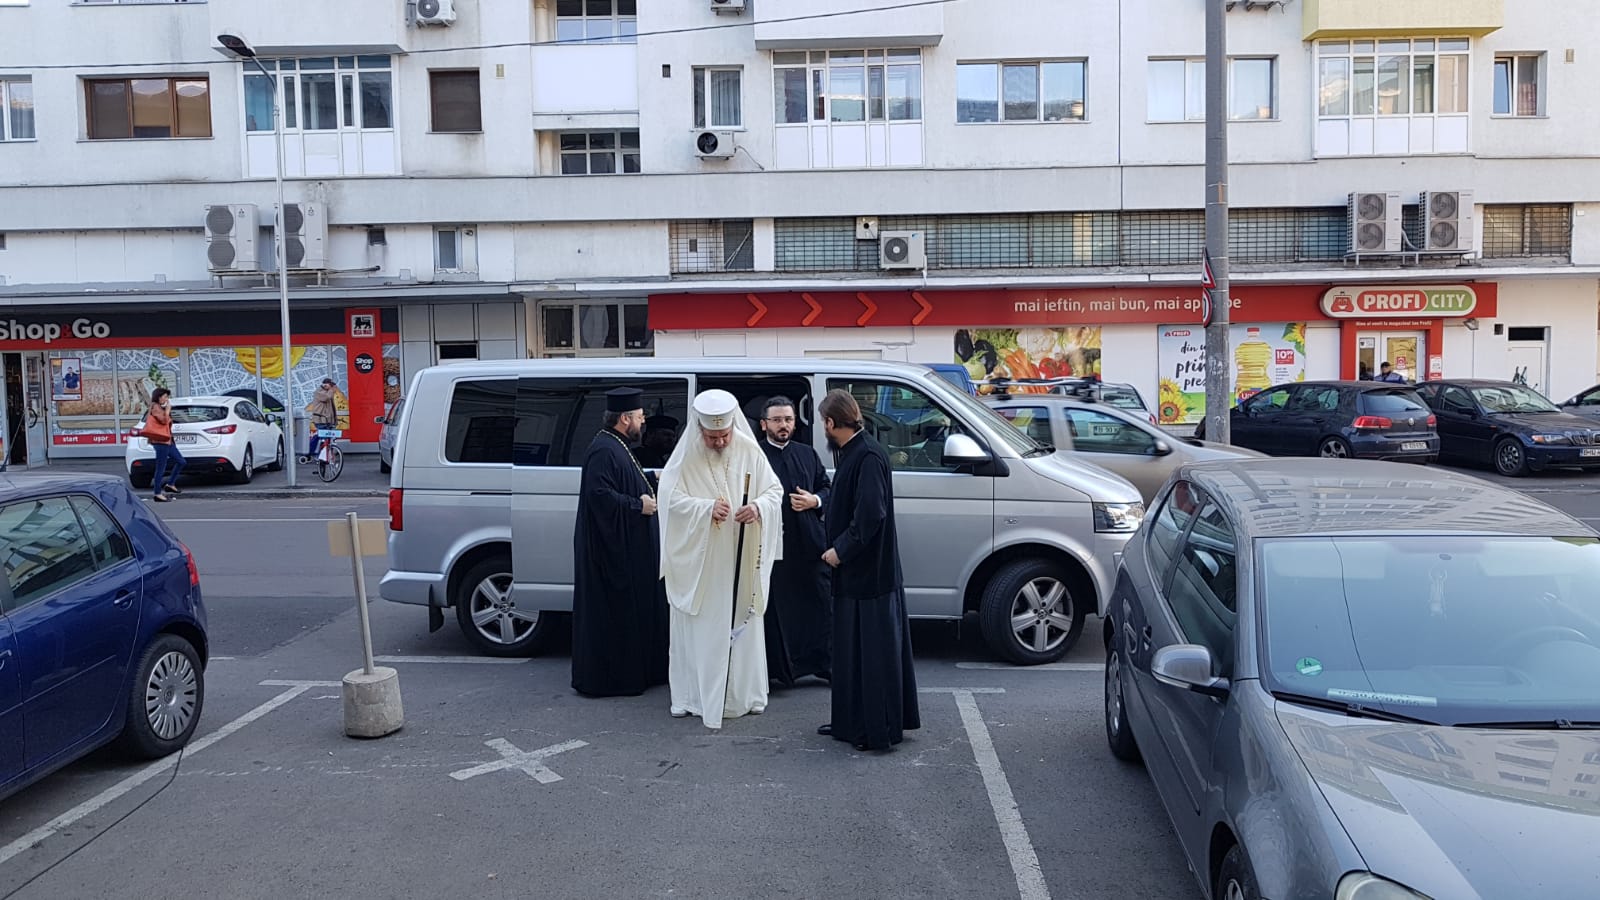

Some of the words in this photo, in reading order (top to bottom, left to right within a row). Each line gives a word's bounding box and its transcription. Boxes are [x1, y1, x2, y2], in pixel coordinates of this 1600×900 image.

[1014, 298, 1040, 312] mai
[1044, 298, 1085, 314] ieftin,
[1089, 297, 1115, 311] mai
[1119, 297, 1150, 313] bun,
[1154, 296, 1180, 310] mai
[1363, 294, 1420, 309] PROFI
[1430, 294, 1466, 308] CITY
[1180, 341, 1199, 354] din
